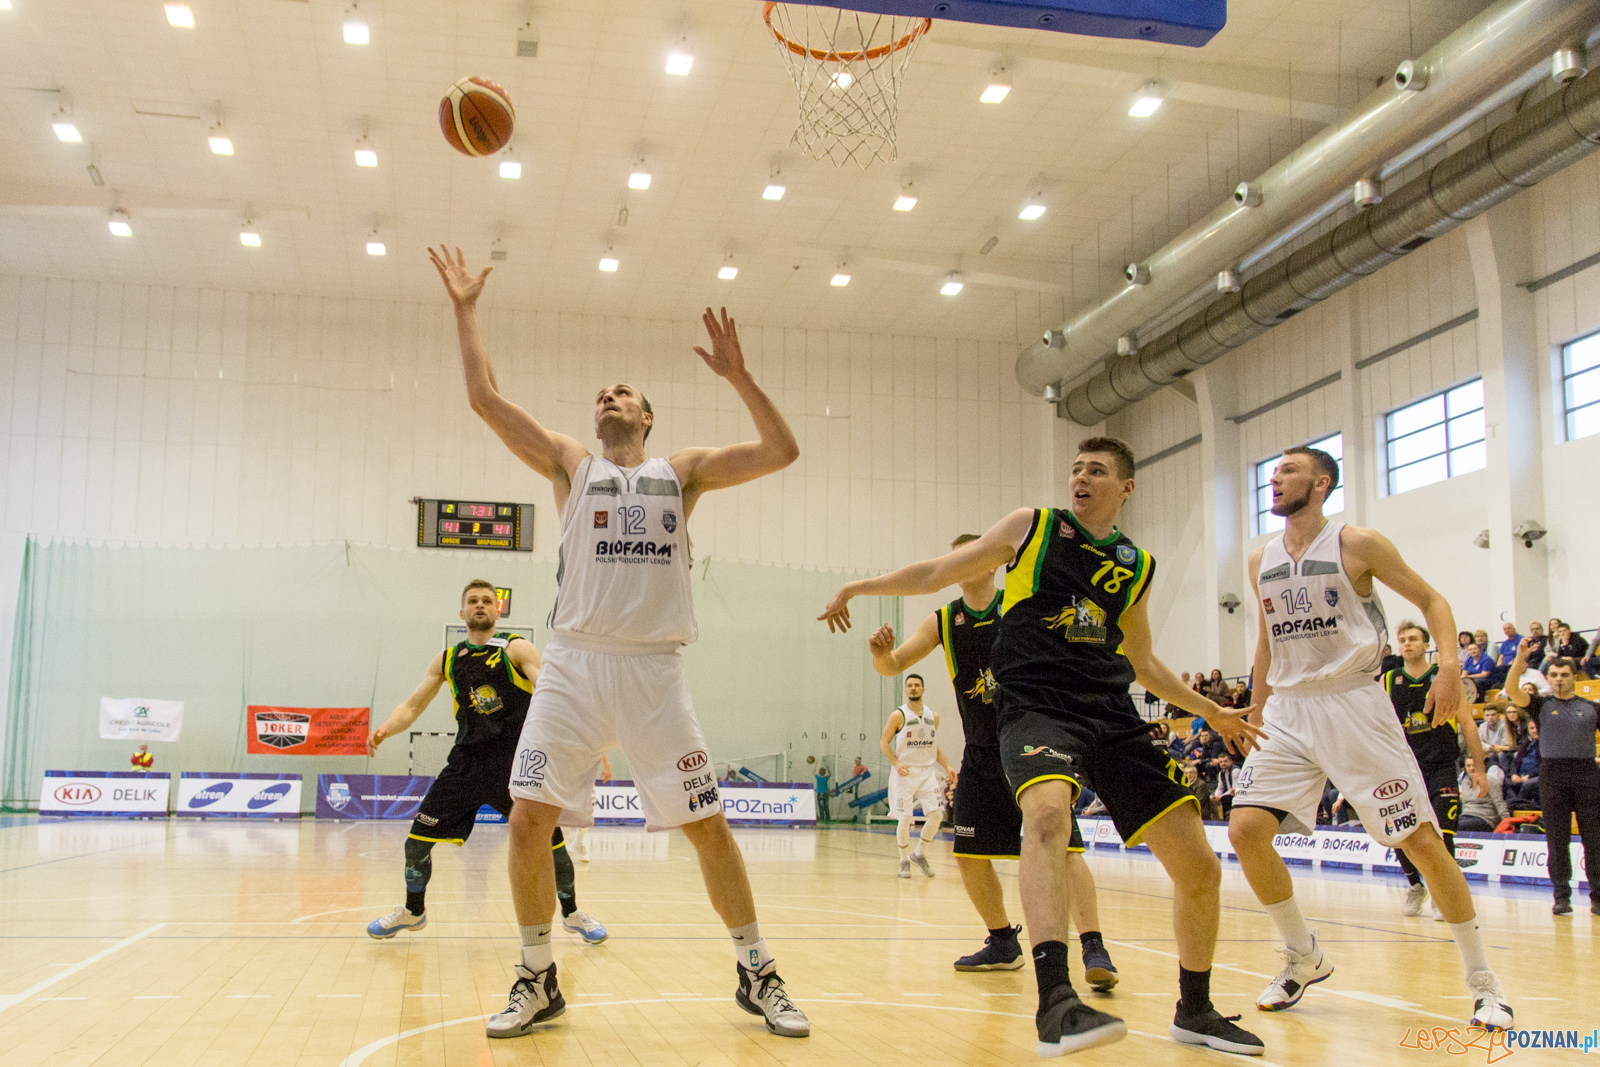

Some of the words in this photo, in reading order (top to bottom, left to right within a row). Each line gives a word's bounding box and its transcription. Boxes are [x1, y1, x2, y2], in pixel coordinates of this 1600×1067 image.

[446, 504, 454, 514] 2
[502, 507, 507, 515] 1
[618, 505, 647, 535] 12
[445, 522, 460, 533] 41
[472, 523, 480, 533] 3
[495, 524, 510, 535] 41
[1091, 560, 1134, 594] 18
[1281, 587, 1312, 615] 14
[1500, 611, 1508, 622] C
[485, 648, 501, 669] 4
[263, 723, 302, 734] JOKER
[821, 732, 827, 740] B
[840, 733, 847, 741] C
[859, 733, 866, 741] D
[519, 749, 547, 780] 12
[682, 754, 706, 769] KIA
[683, 772, 713, 791] DELIK
[62, 788, 93, 800] KIA
[113, 789, 157, 800] DELIK
[195, 789, 225, 799] atrem
[254, 789, 283, 800] atrem
[1379, 782, 1404, 797] KIA
[698, 787, 718, 808] PBG
[1379, 798, 1413, 817] DELIK
[1393, 813, 1417, 832] PBG
[1274, 836, 1317, 848] BIOFARM
[1322, 838, 1370, 852] BIOFARM
[1456, 850, 1478, 858] JOKER
[1520, 851, 1548, 867] NIC
